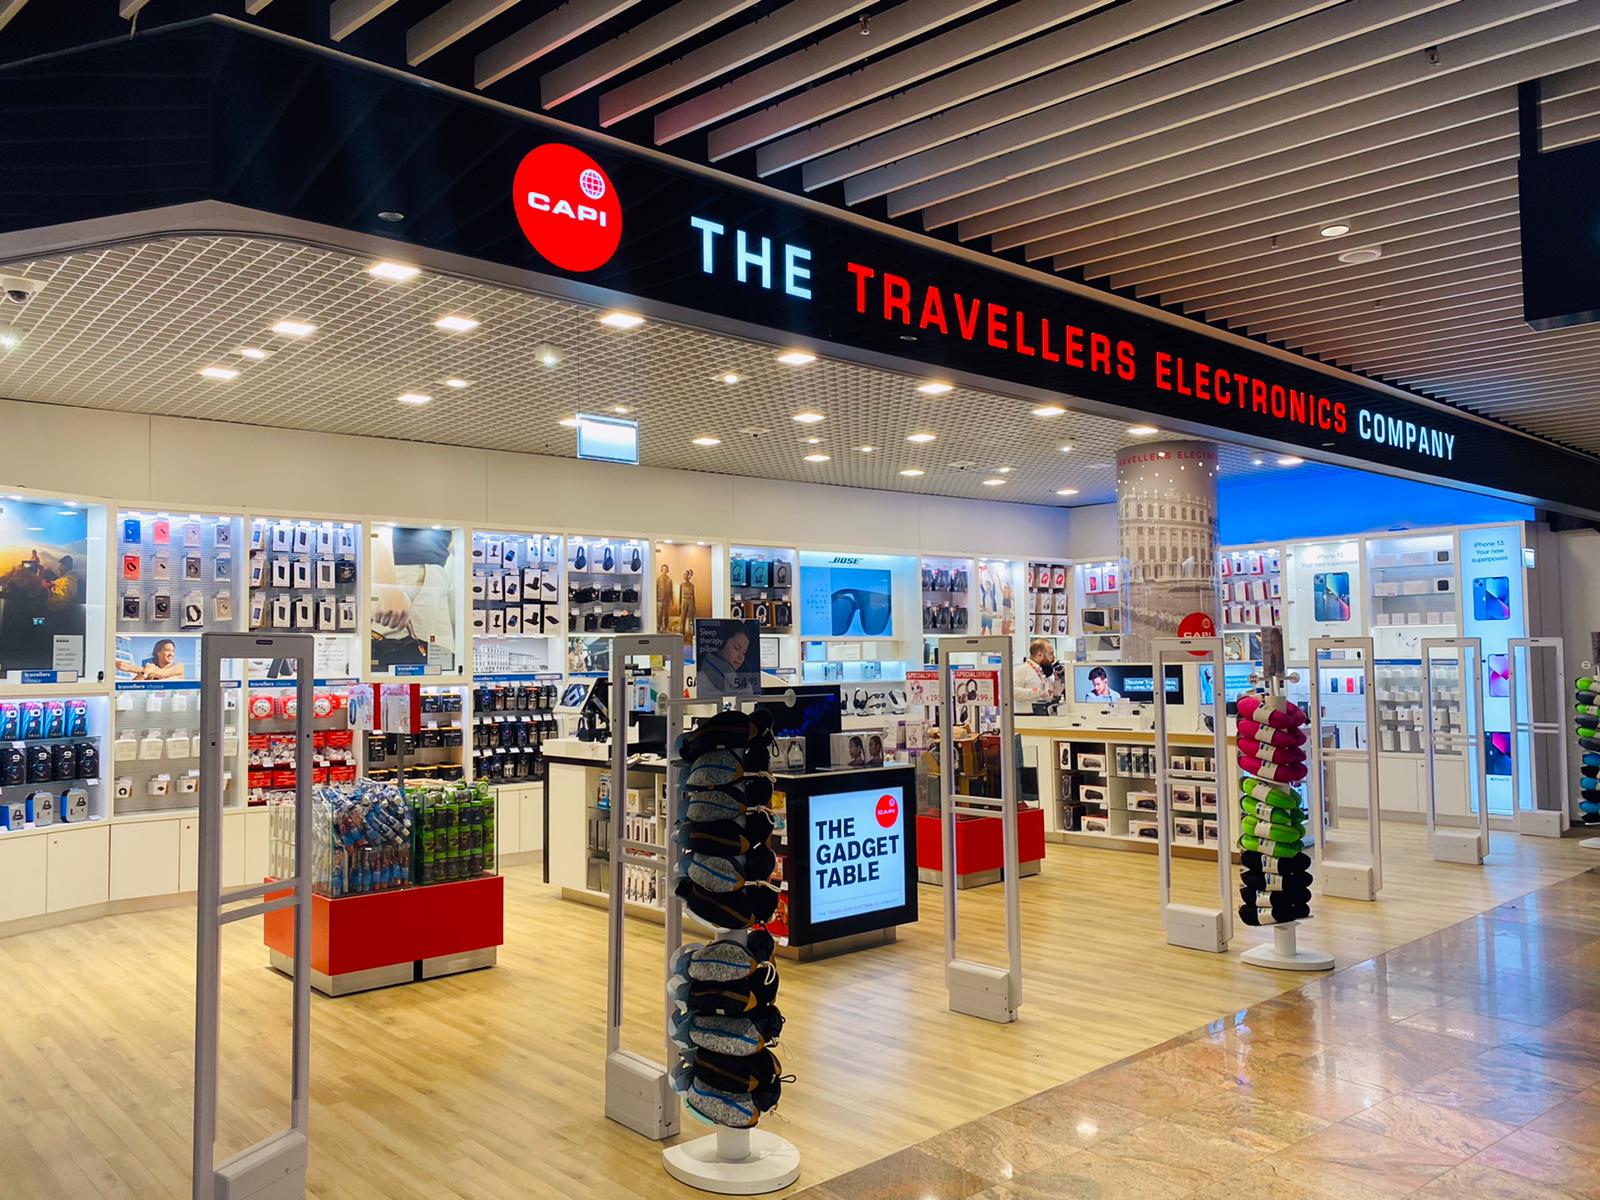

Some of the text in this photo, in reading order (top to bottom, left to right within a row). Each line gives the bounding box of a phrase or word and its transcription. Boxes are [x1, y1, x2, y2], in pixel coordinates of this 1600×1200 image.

[527, 191, 607, 228] CAPI
[690, 215, 1455, 461] THE TRAVELLERS ELECTRONICS COMPANY
[1119, 452, 1172, 465] RAVELLERS
[829, 556, 863, 565] BOSE
[700, 627, 718, 637] Sleep
[700, 637, 723, 646] therapy
[686, 676, 697, 688] G
[6, 710, 17, 718] 10
[29, 709, 41, 717] 10
[52, 708, 63, 716] 10
[75, 707, 86, 715] 10
[815, 817, 856, 841] THE
[816, 834, 900, 866] GADGET
[816, 860, 880, 890] TABLE
